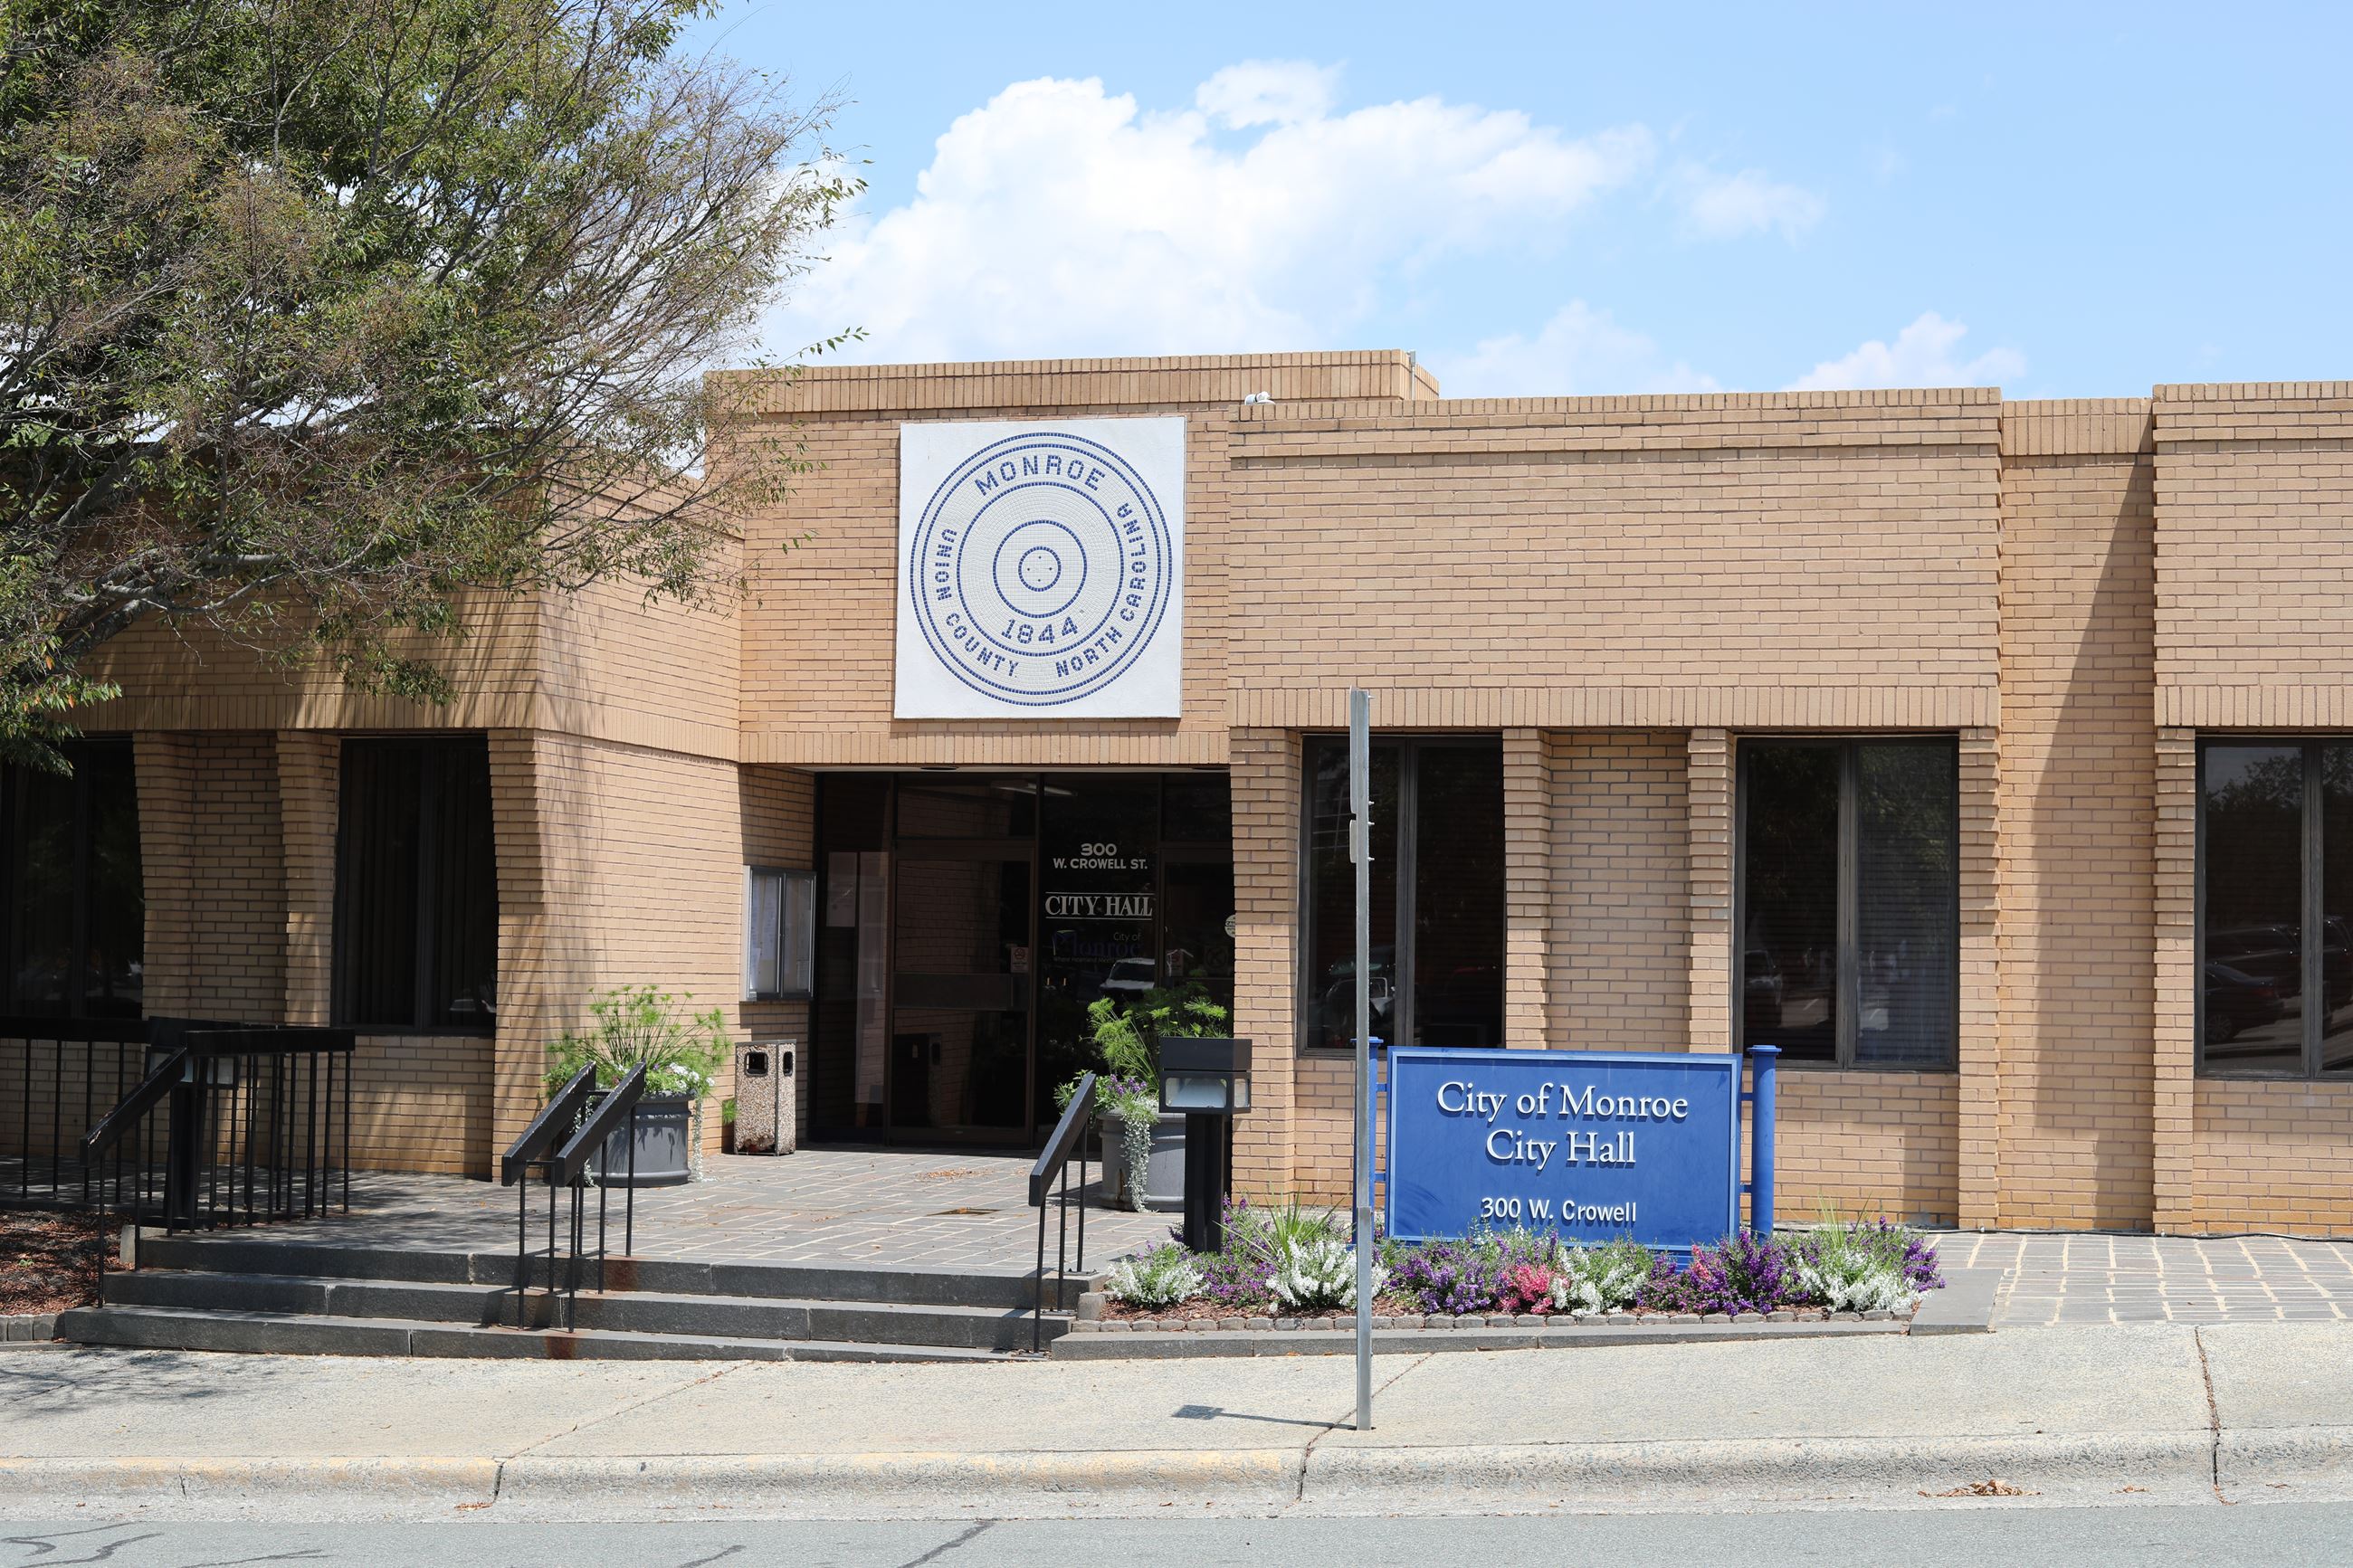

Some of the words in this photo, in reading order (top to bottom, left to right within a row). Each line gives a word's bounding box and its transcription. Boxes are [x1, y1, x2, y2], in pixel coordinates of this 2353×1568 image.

[974, 454, 1106, 497] MONROE
[934, 528, 957, 601] UNION
[946, 613, 1019, 677] COUNTY
[1055, 625, 1123, 678] NORTH
[1116, 502, 1147, 622] CAROLINA
[1001, 616, 1079, 644] 1844
[1081, 842, 1118, 856] 300
[1053, 858, 1067, 869] W.
[1070, 858, 1127, 870] CROWELL
[1130, 859, 1148, 870] ST.
[1044, 896, 1100, 916] CITY
[1104, 896, 1153, 917] HALL
[1112, 932, 1130, 942] City
[1131, 932, 1142, 941] of
[1437, 1081, 1507, 1123] City
[1517, 1083, 1554, 1116] of
[1558, 1085, 1689, 1118] Monroe
[1486, 1129, 1557, 1171] City
[1567, 1131, 1636, 1164] Hall
[1481, 1197, 1521, 1220] 300
[1529, 1199, 1554, 1220] W.
[1562, 1200, 1636, 1222] Crowell
